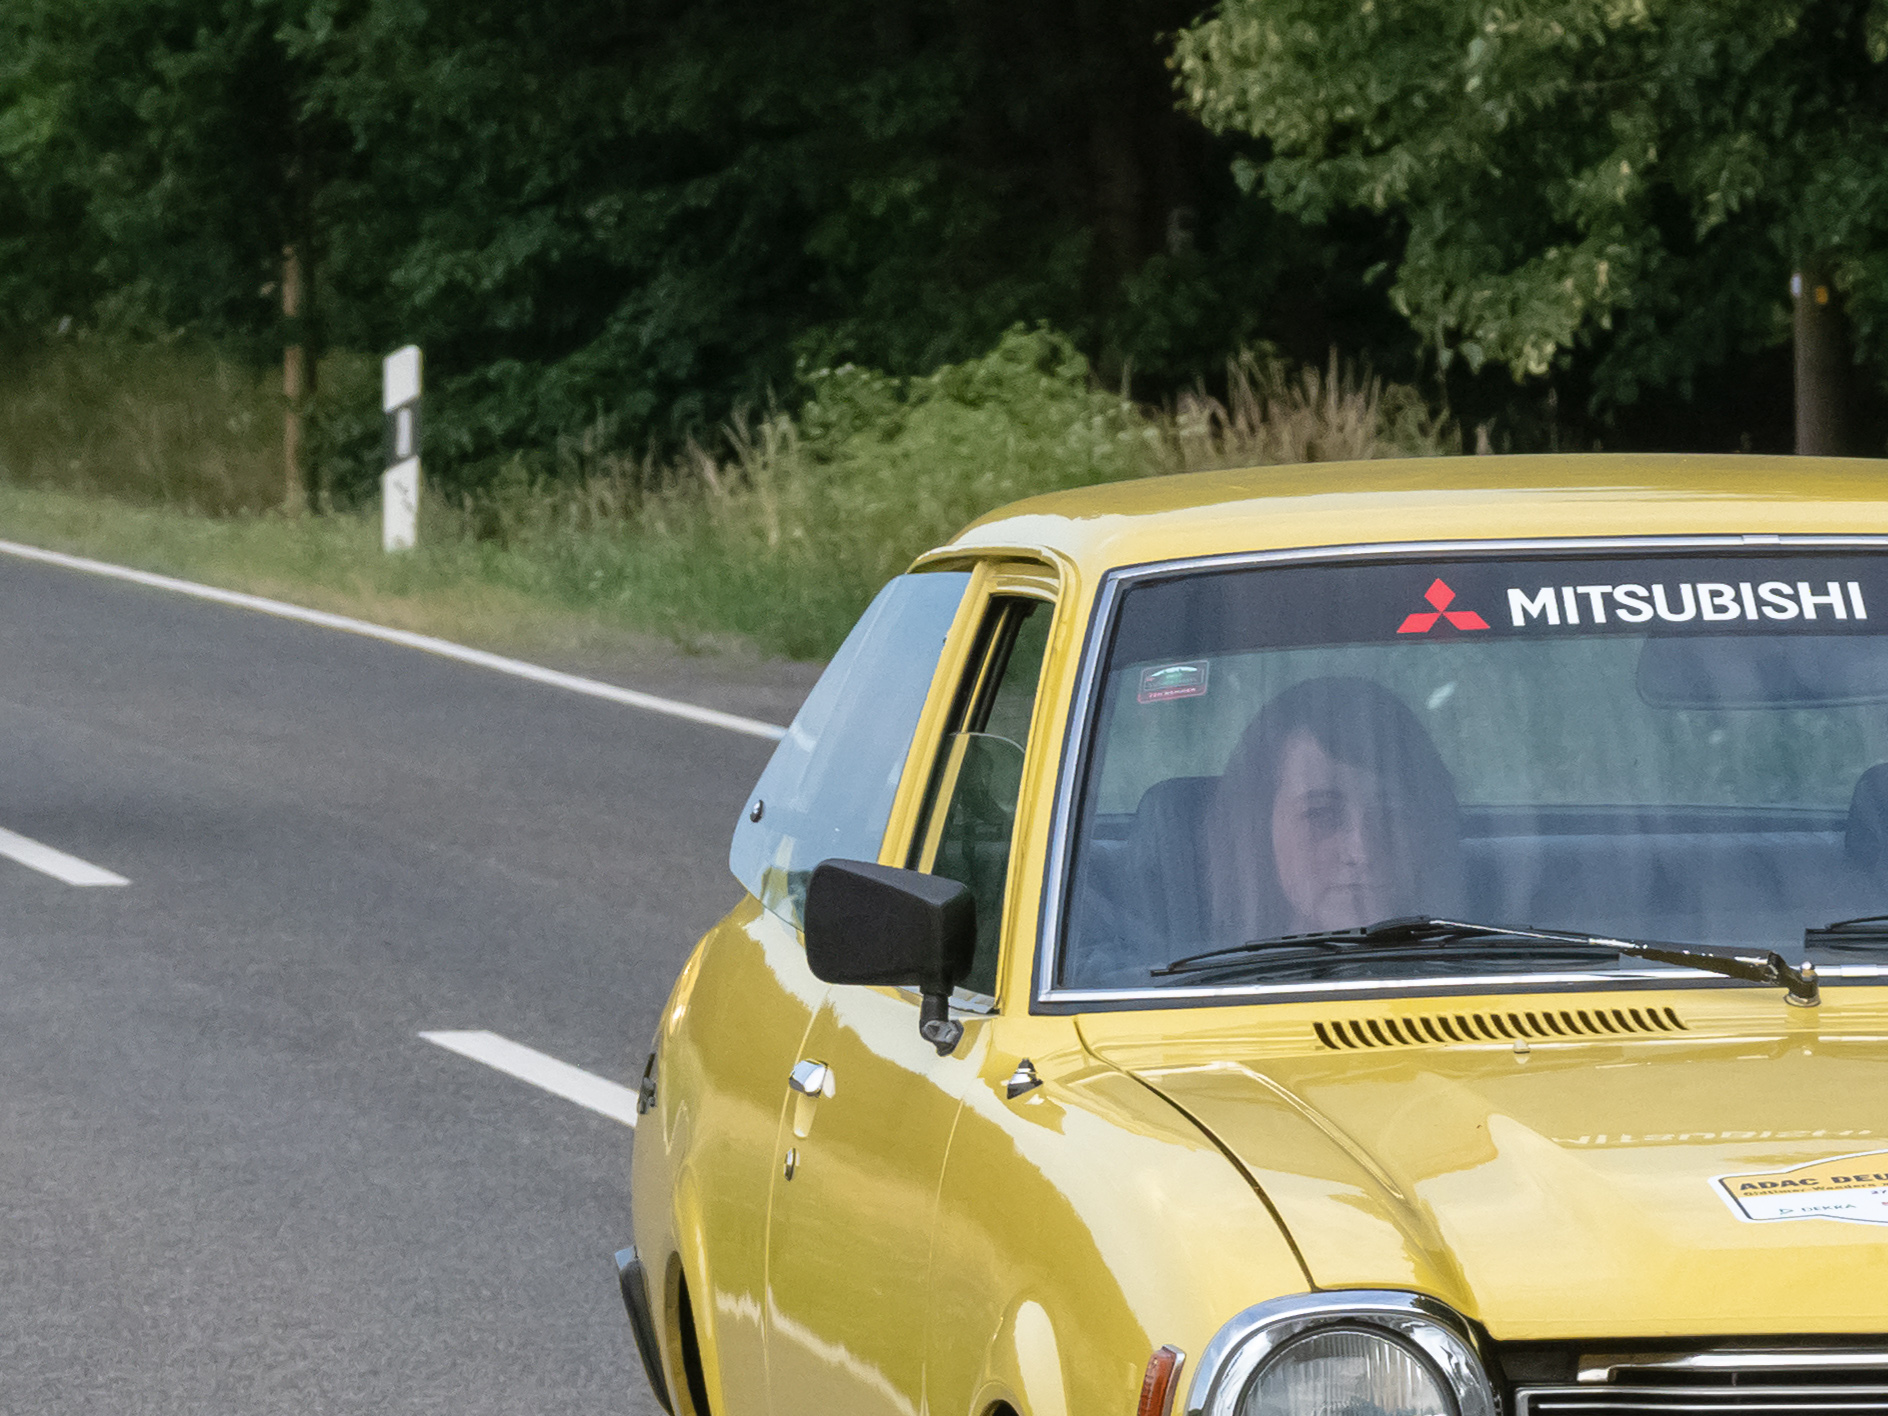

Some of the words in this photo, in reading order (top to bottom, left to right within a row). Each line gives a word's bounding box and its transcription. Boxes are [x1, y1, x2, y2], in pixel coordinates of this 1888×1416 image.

[1507, 580, 1868, 627] MITSUBISHI
[1740, 1177, 1820, 1191] ADAC
[1801, 1203, 1857, 1213] DEKRA
